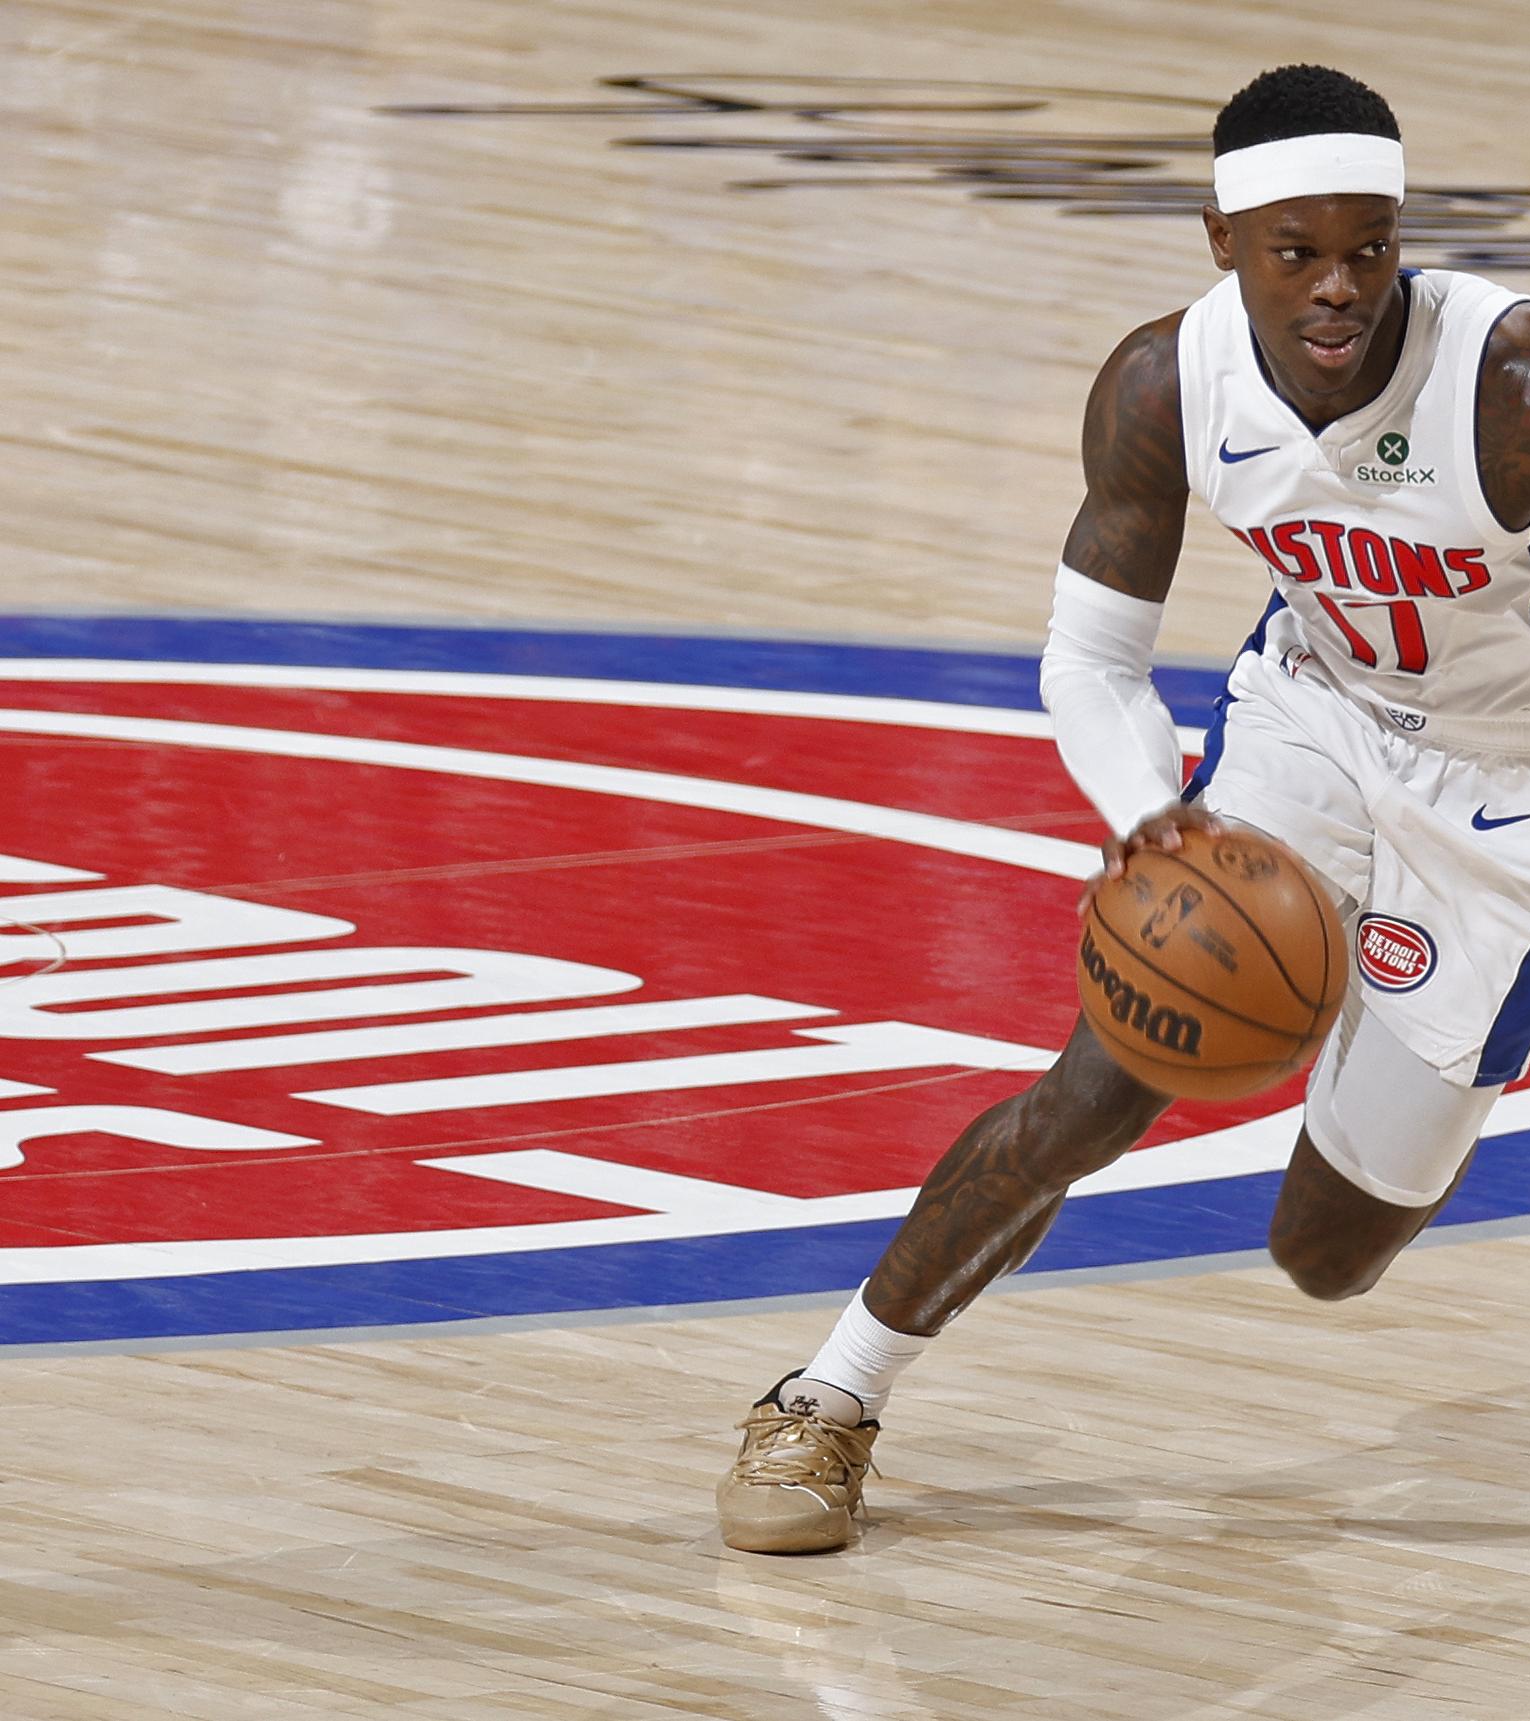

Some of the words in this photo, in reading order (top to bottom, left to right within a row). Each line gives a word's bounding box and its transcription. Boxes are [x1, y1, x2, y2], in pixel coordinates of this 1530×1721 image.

[1357, 466, 1435, 485] StockX
[1229, 519, 1492, 599] ISTONS
[1315, 590, 1429, 675] 17
[1363, 939, 1416, 975] PISTONS
[1368, 928, 1421, 962] DETROIT
